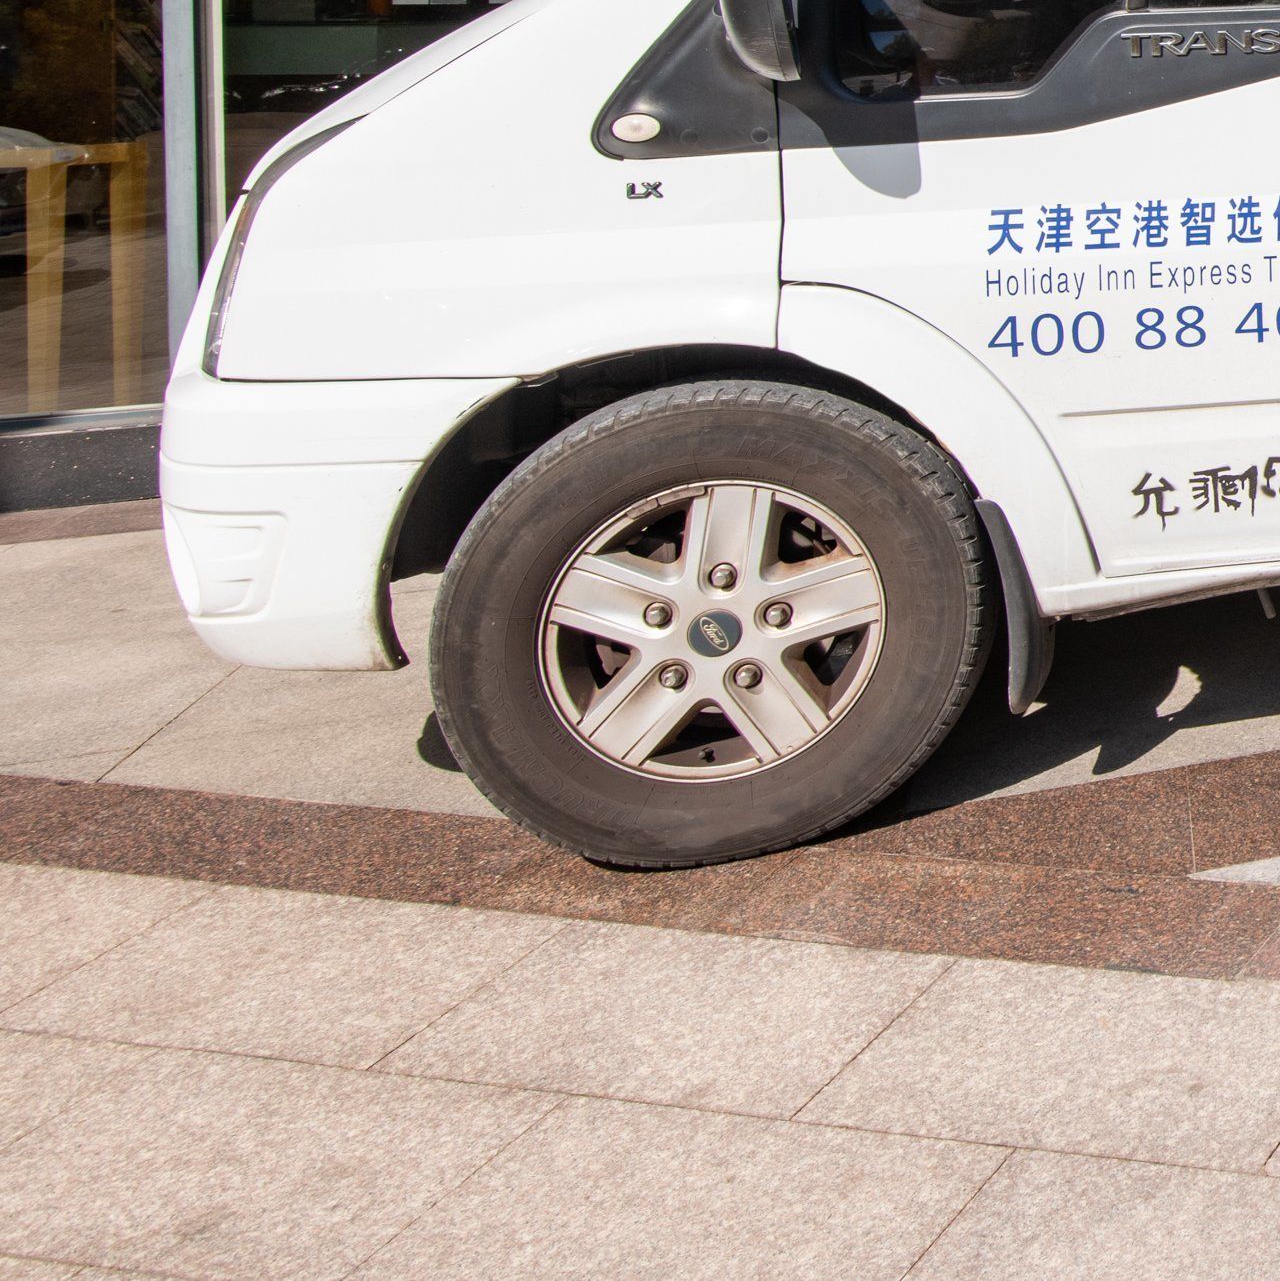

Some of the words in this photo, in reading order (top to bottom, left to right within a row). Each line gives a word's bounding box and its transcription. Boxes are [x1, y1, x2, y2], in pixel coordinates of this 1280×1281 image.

[626, 181, 664, 199] LX
[985, 267, 1085, 300] Holiday
[1098, 264, 1136, 291] Inn
[1149, 260, 1253, 294] Express
[987, 310, 1105, 358] 400
[1134, 305, 1207, 351] 88
